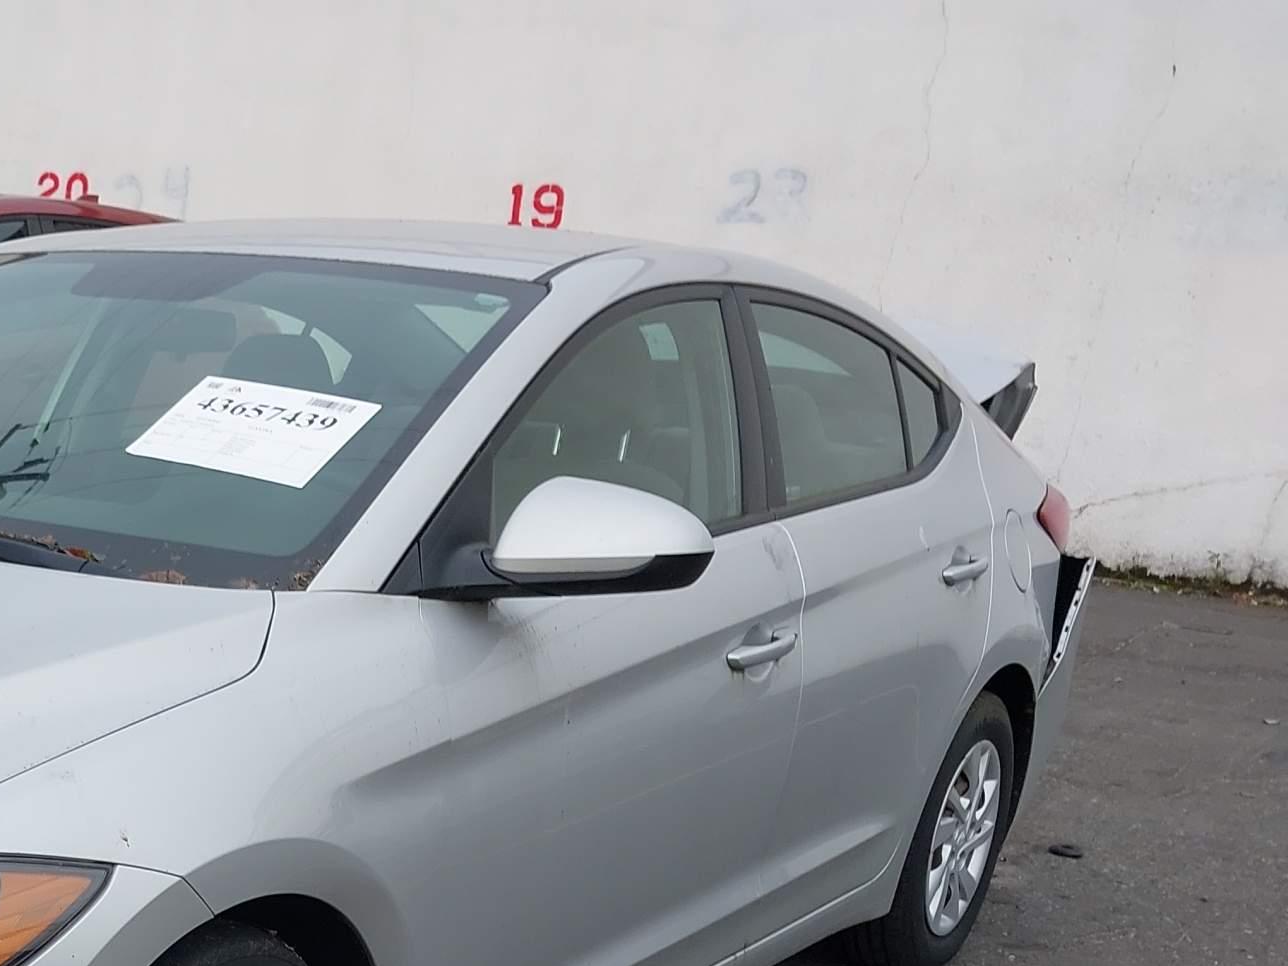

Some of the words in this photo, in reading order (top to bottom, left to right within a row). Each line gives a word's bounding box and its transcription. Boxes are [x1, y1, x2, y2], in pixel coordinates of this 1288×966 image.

[37, 171, 89, 200] 20
[507, 184, 565, 229] 19
[196, 396, 339, 431] 43657439
